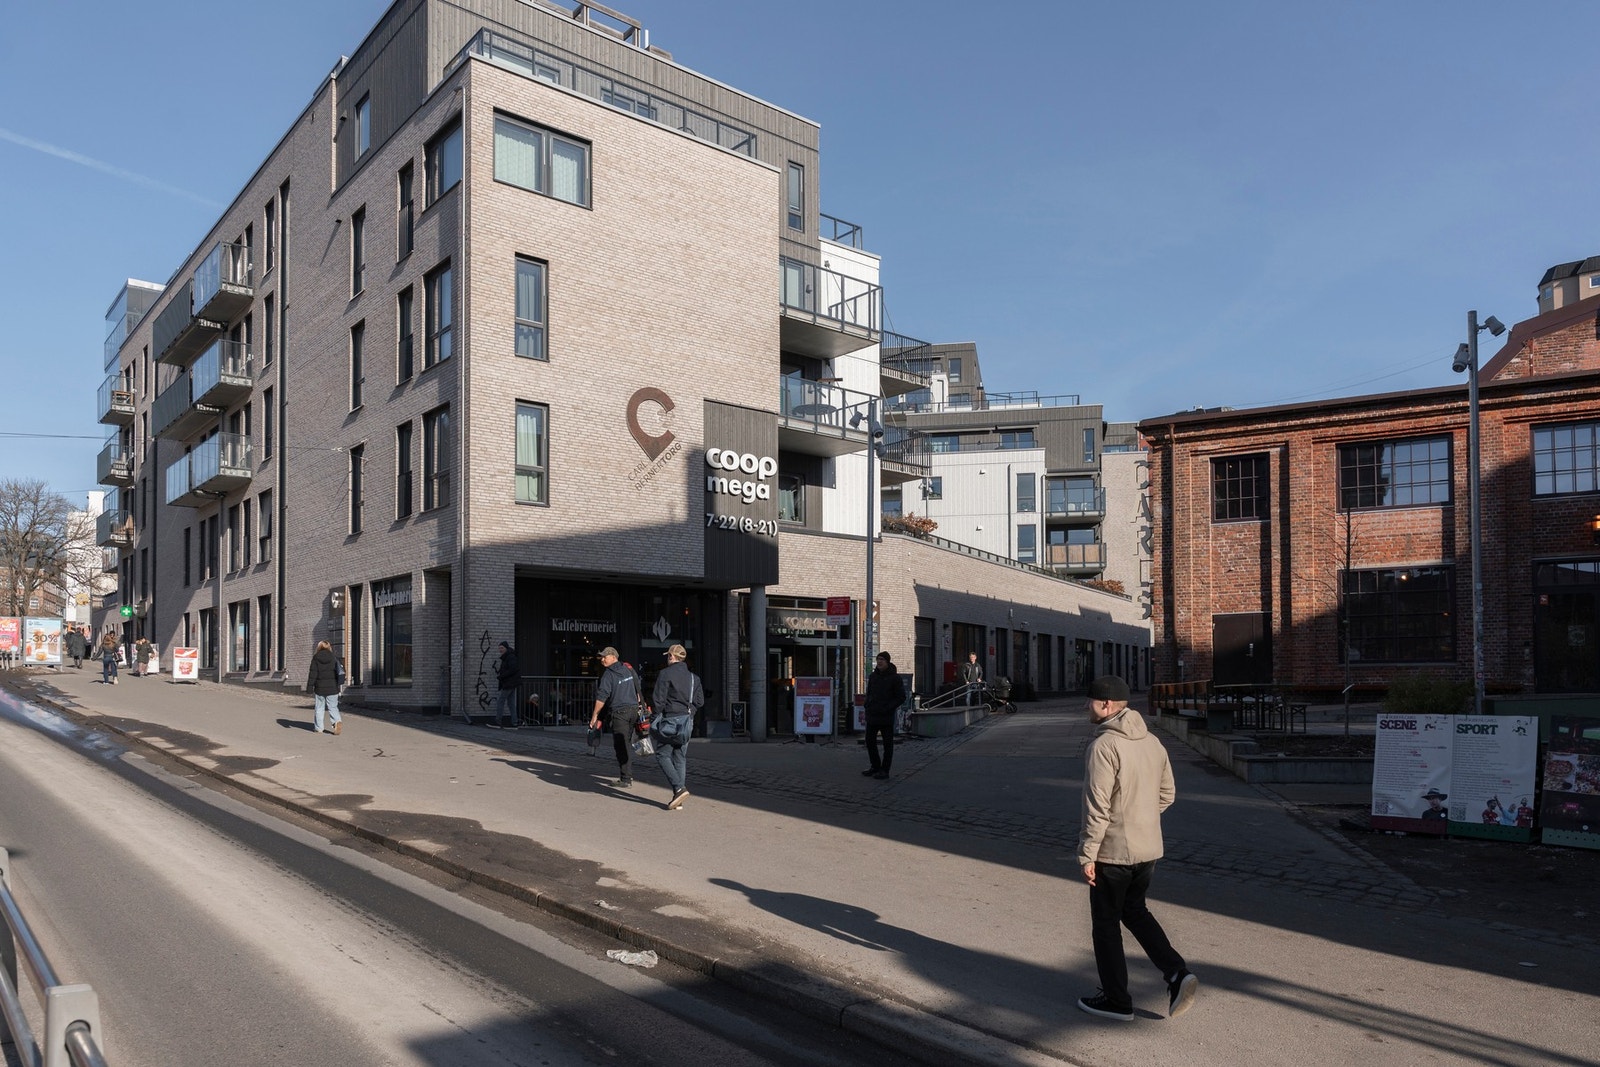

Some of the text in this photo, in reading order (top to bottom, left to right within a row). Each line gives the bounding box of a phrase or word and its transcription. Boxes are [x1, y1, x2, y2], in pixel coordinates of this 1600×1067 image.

[627, 459, 649, 481] CARL
[634, 441, 682, 492] BERNERTORG
[705, 447, 778, 480] coop
[706, 474, 770, 503] mega
[375, 585, 412, 609] Kaffebrenneri
[552, 617, 617, 633] Kaffebrenneriet
[30, 633, 58, 643] -30%
[1379, 719, 1418, 730] SCENE
[1455, 723, 1499, 735] SPORT
